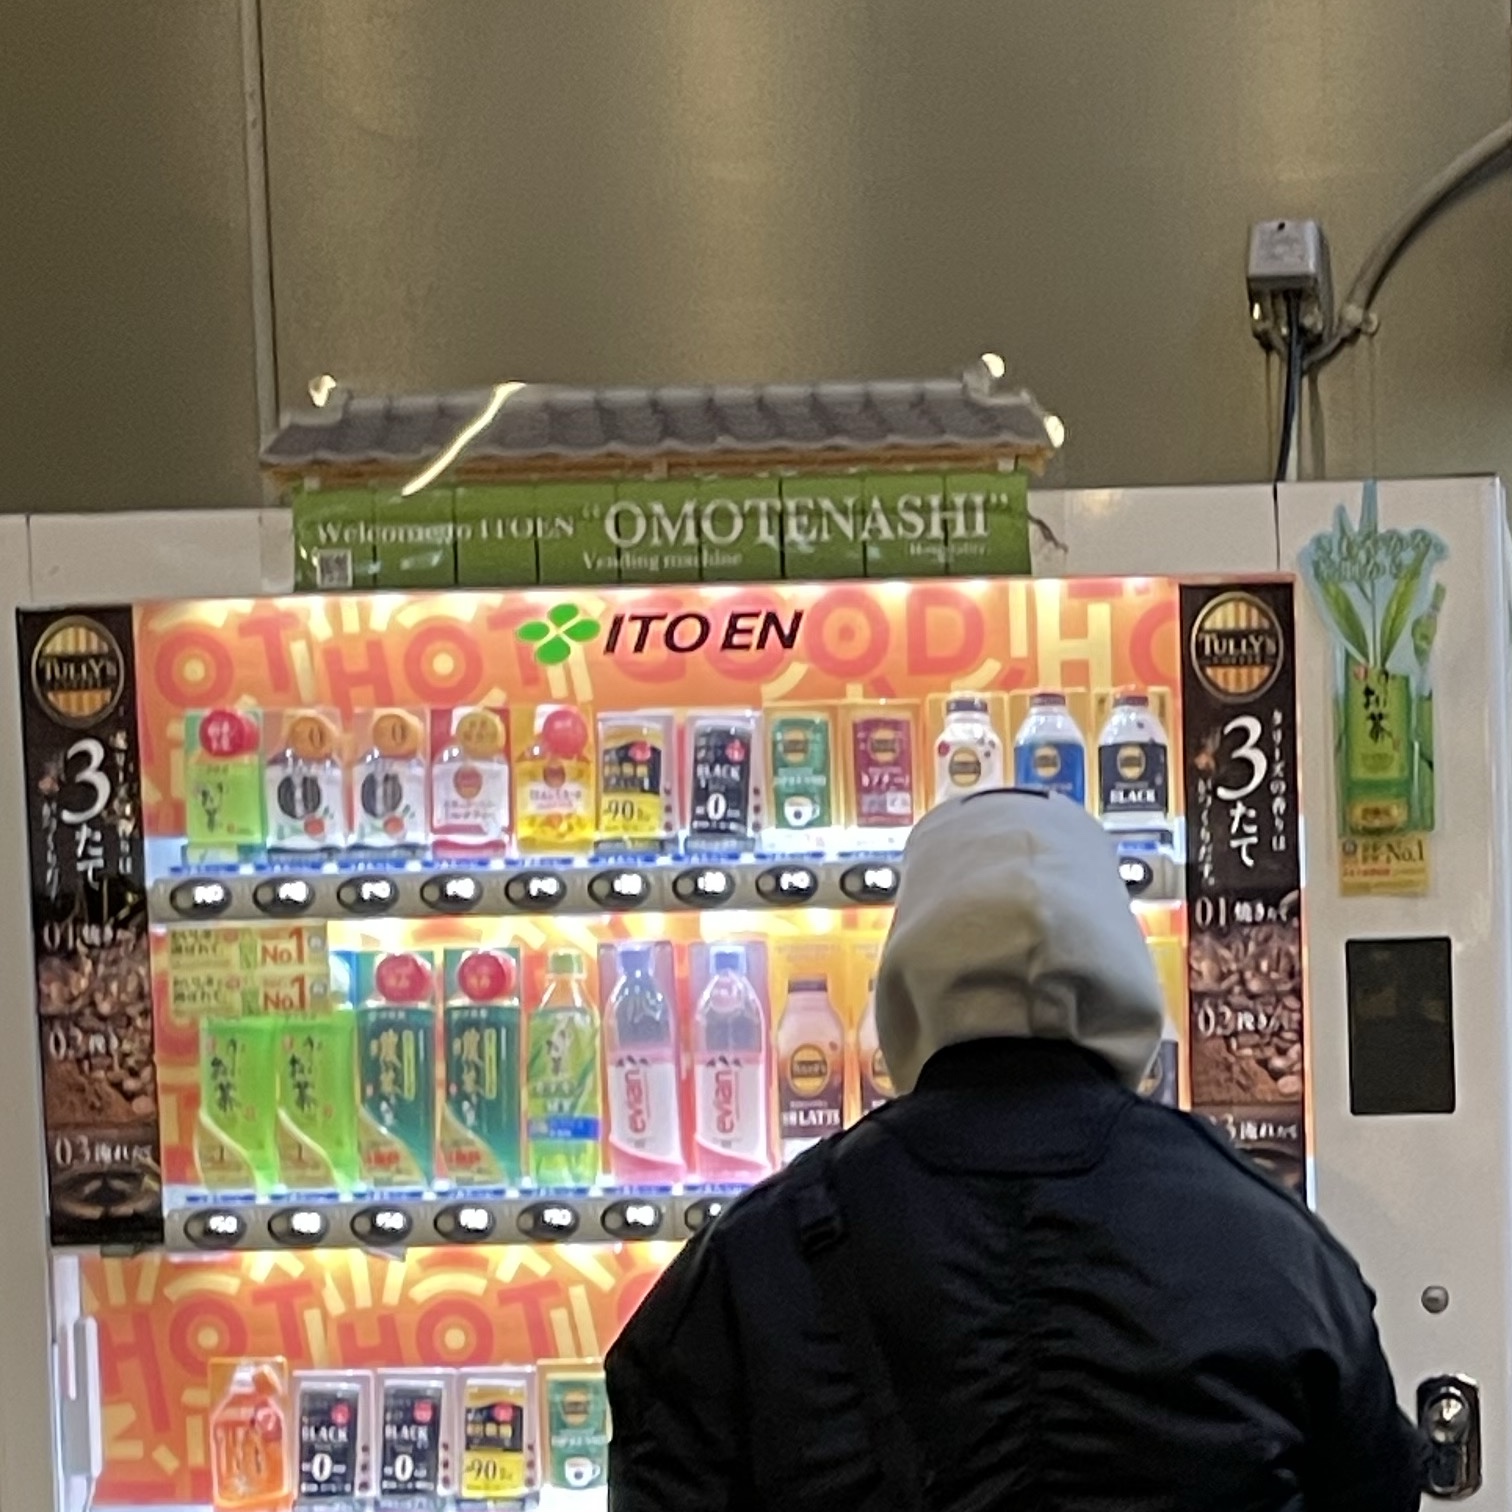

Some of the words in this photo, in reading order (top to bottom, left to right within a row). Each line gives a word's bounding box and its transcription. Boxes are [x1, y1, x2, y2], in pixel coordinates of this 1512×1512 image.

[603, 611, 711, 655] ITO
[720, 609, 804, 653] EN
[1109, 788, 1156, 804] BLACK
[302, 1425, 348, 1442] BLACK
